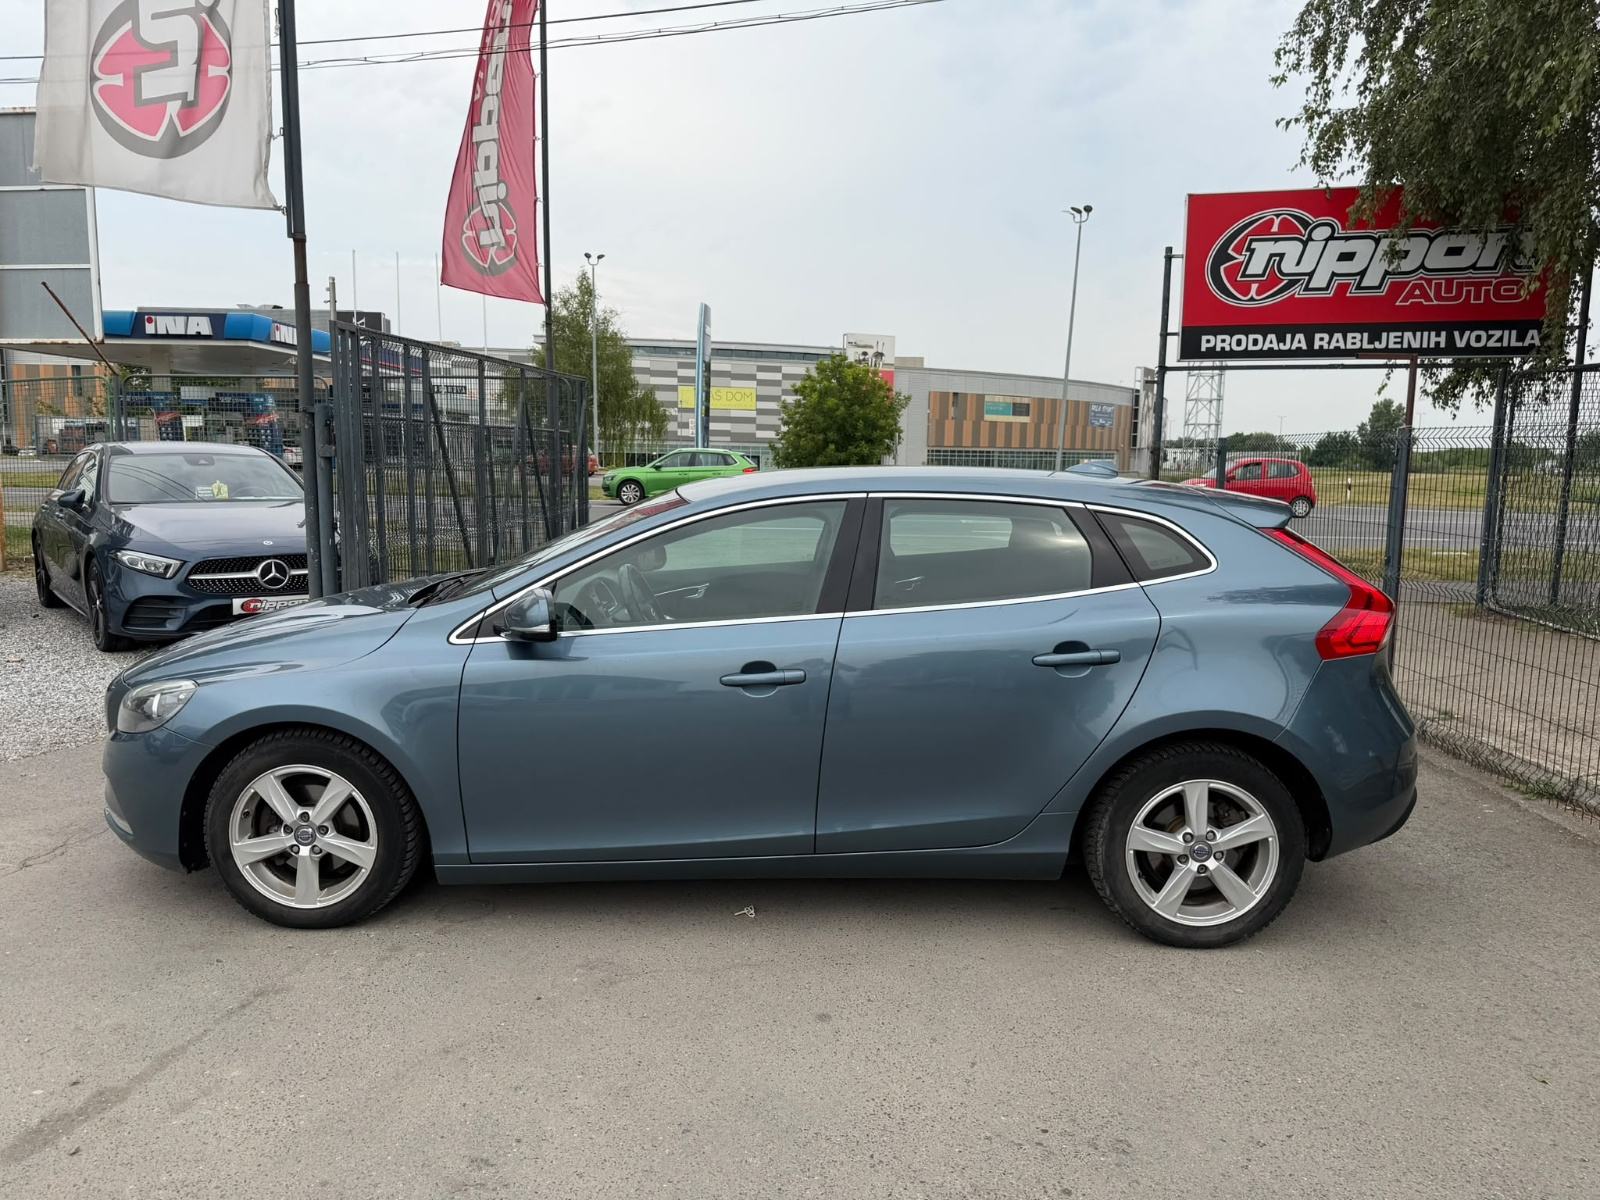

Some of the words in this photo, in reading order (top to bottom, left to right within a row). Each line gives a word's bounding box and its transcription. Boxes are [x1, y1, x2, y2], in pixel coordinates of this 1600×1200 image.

[1396, 278, 1529, 306] AUTO
[145, 315, 213, 336] INA
[274, 323, 298, 346] IN
[1200, 334, 1307, 353] PRODAJA
[1313, 331, 1446, 351] RABLJENIH
[1454, 329, 1541, 348] VOZILA
[726, 391, 753, 402] DOM
